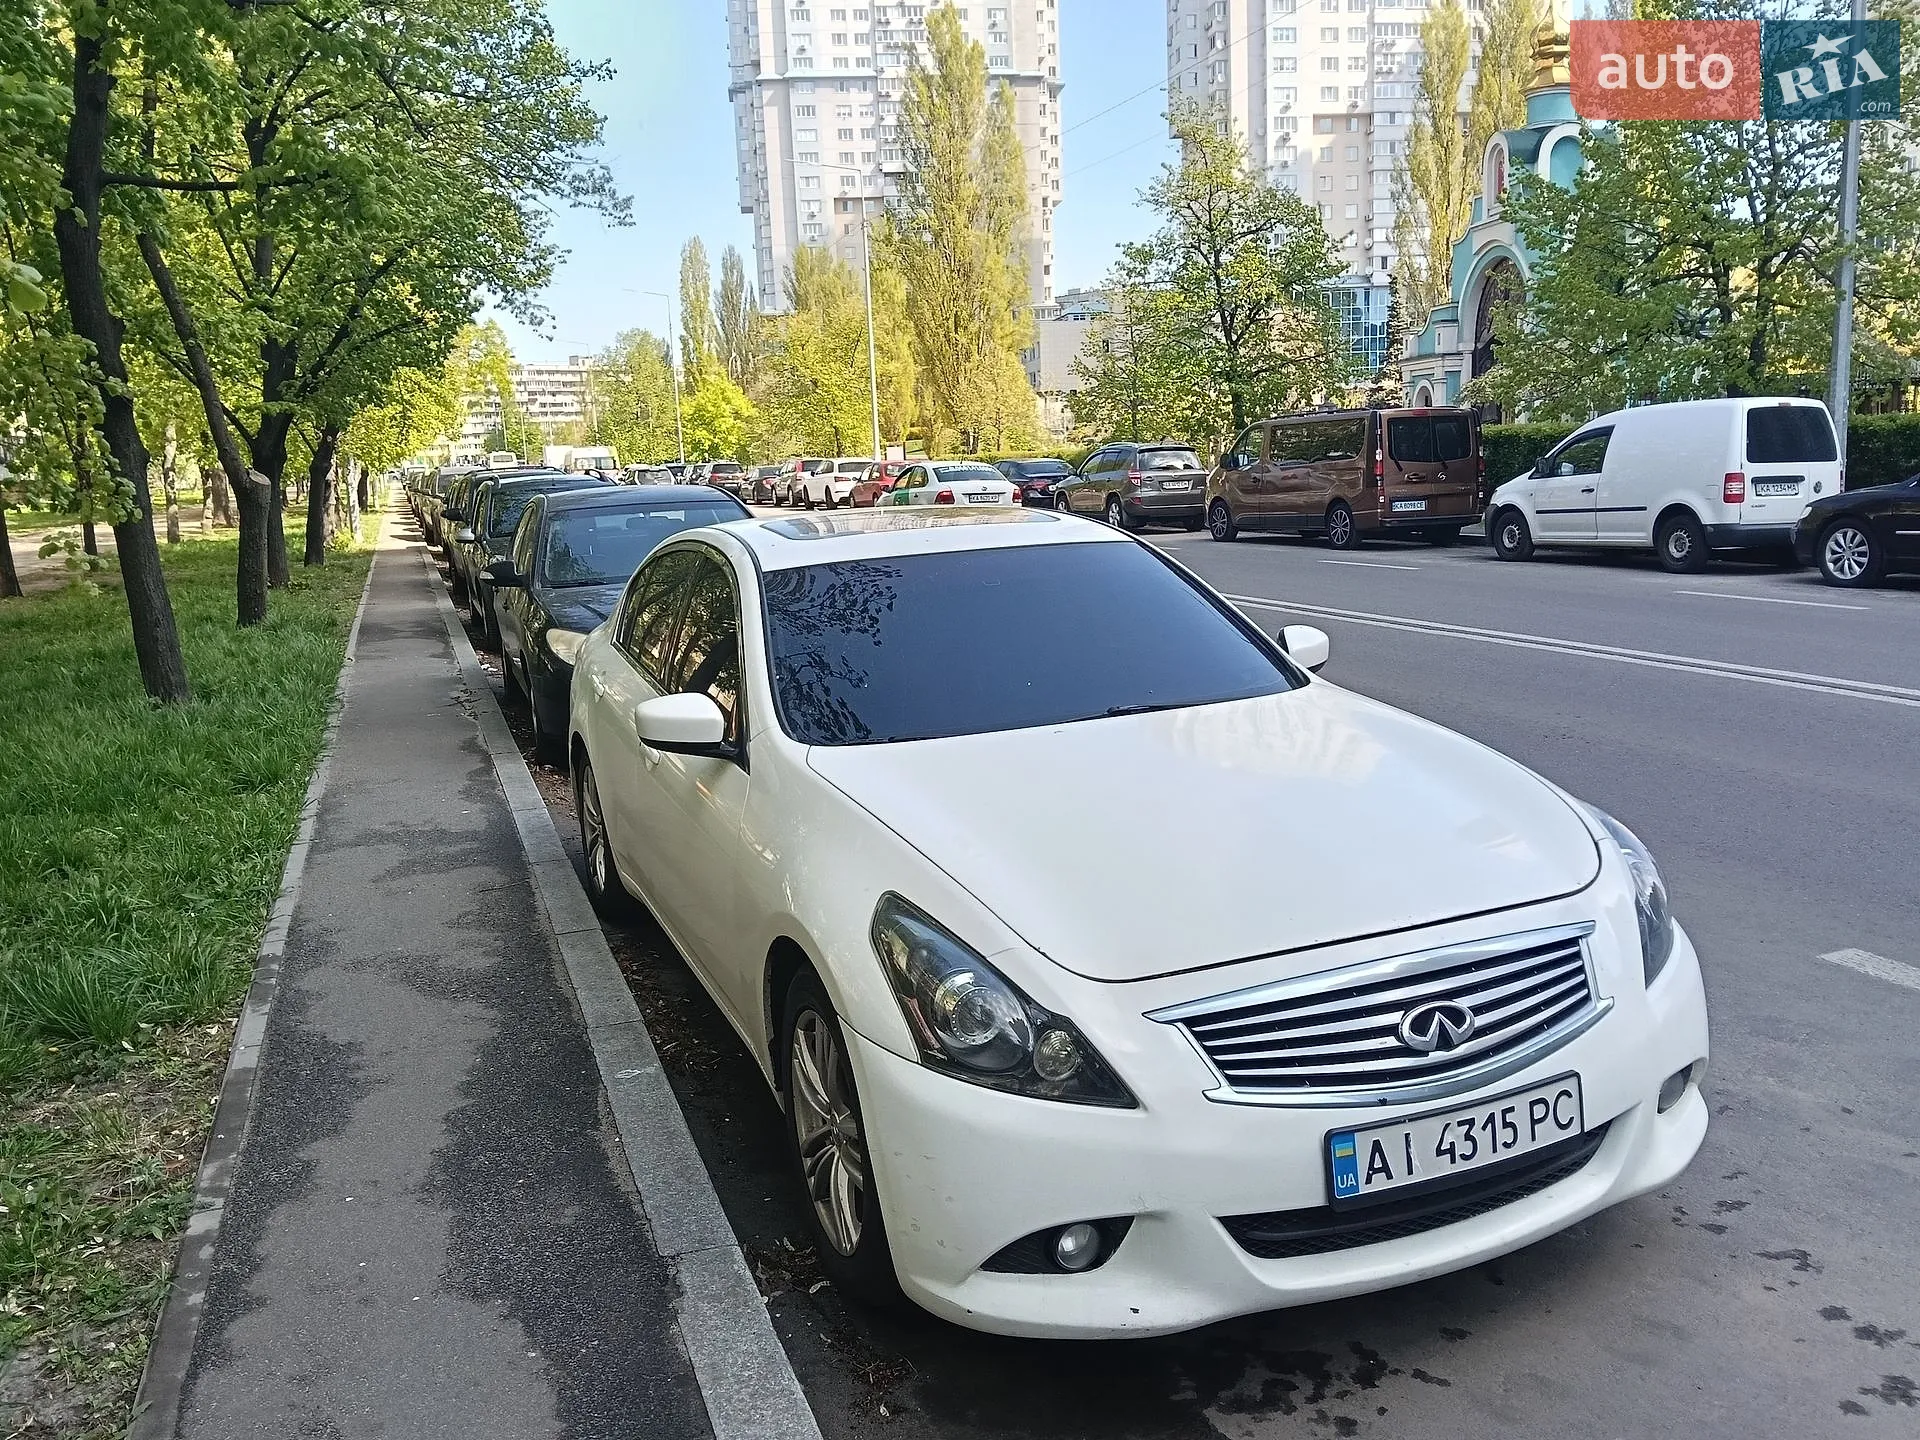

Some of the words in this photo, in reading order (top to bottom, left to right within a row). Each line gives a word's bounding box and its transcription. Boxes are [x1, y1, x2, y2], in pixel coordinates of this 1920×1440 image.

[1365, 1132, 1414, 1185] AI
[1435, 1105, 1519, 1164] 4315
[1528, 1089, 1575, 1142] PC
[1338, 1172, 1357, 1189] UA
